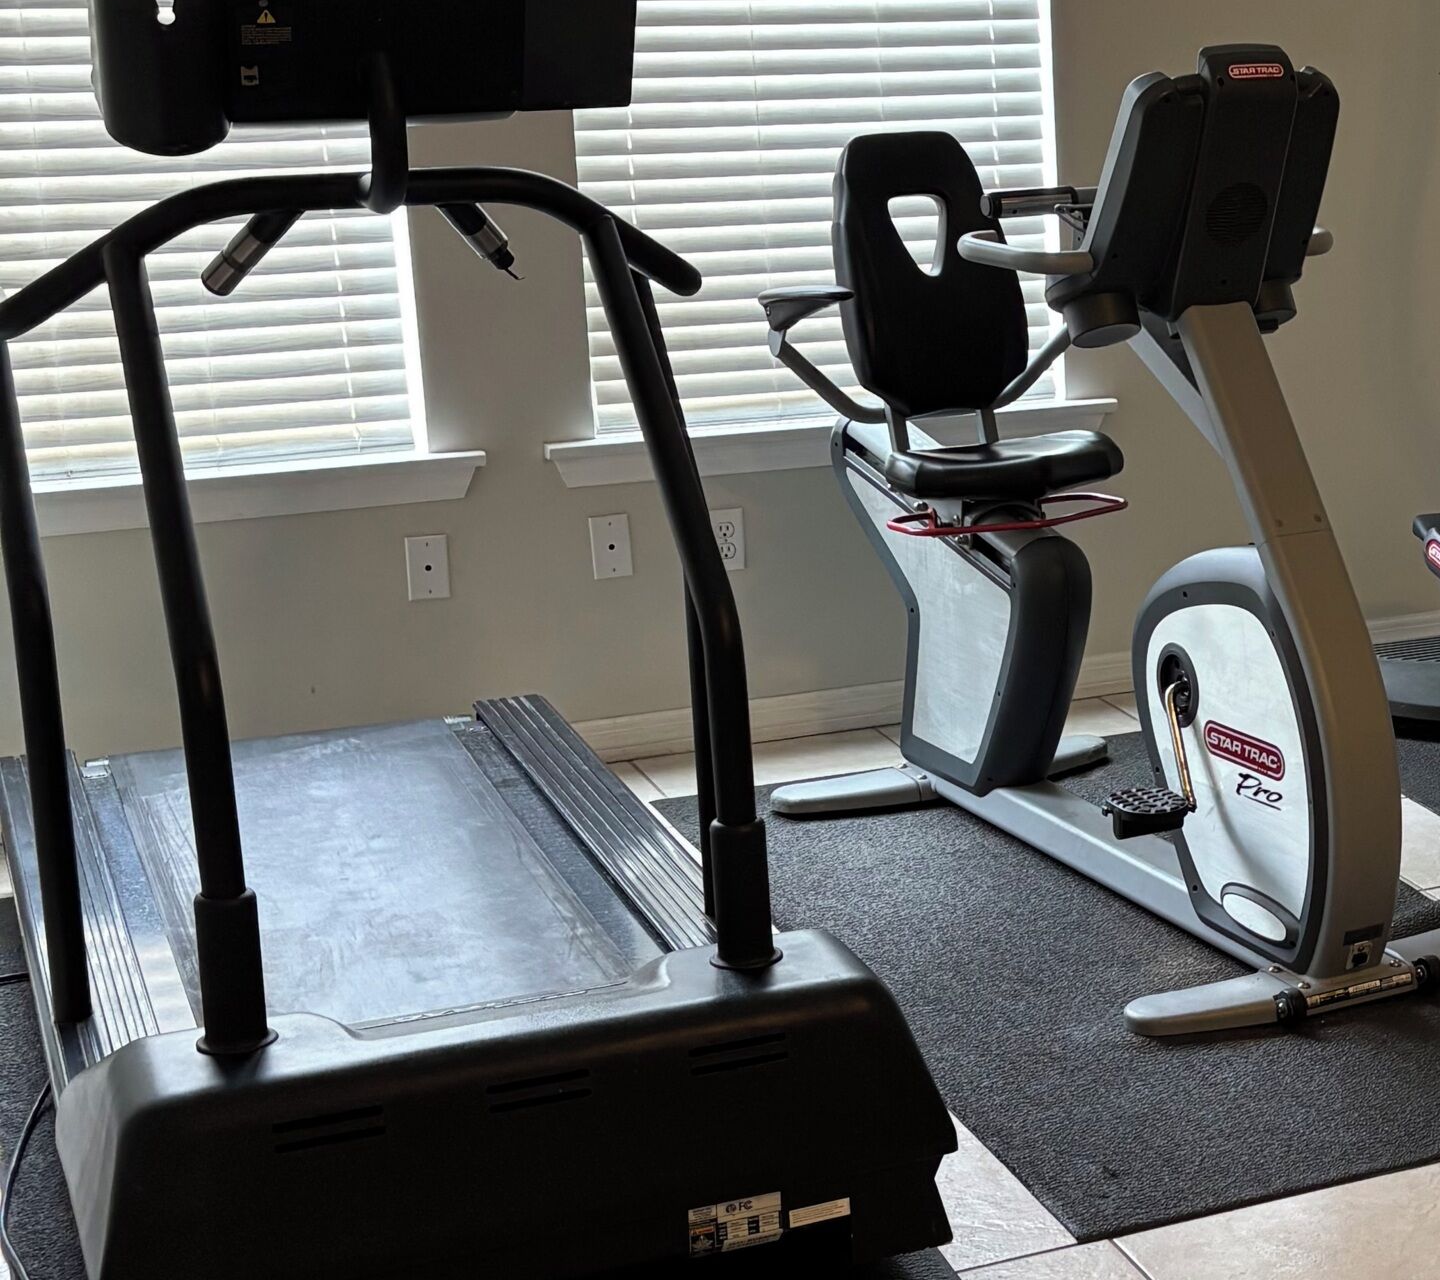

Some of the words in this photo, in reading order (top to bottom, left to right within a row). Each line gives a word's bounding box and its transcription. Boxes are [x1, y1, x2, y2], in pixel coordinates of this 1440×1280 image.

[1232, 67, 1255, 75] STAR
[1256, 66, 1280, 74] TRAC
[1208, 731, 1241, 754] STAR
[1242, 744, 1278, 769] TRAC
[1236, 773, 1283, 802] Pro
